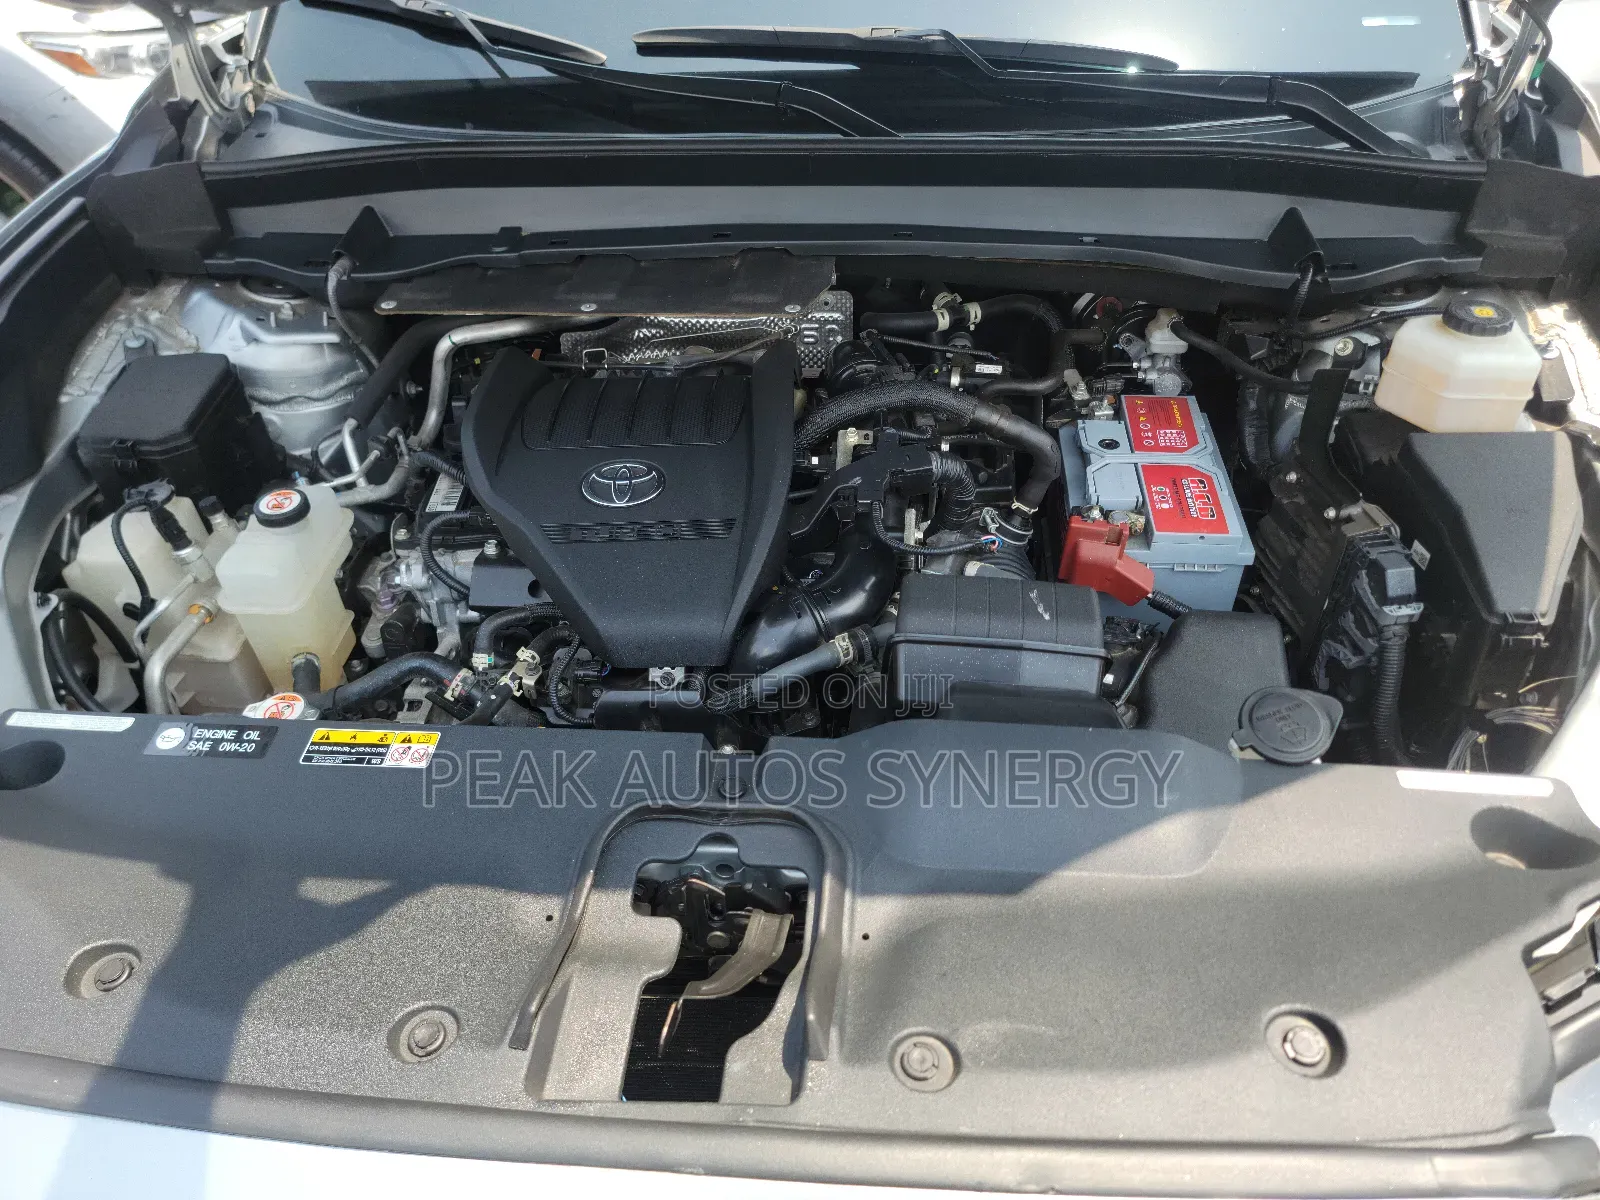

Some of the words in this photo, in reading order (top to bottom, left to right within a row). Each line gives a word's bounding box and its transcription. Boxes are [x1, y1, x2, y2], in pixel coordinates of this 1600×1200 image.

[194, 729, 238, 740] ENGINE
[243, 730, 261, 741] OIL
[187, 740, 213, 751] SAE
[218, 741, 256, 753] 0W-20
